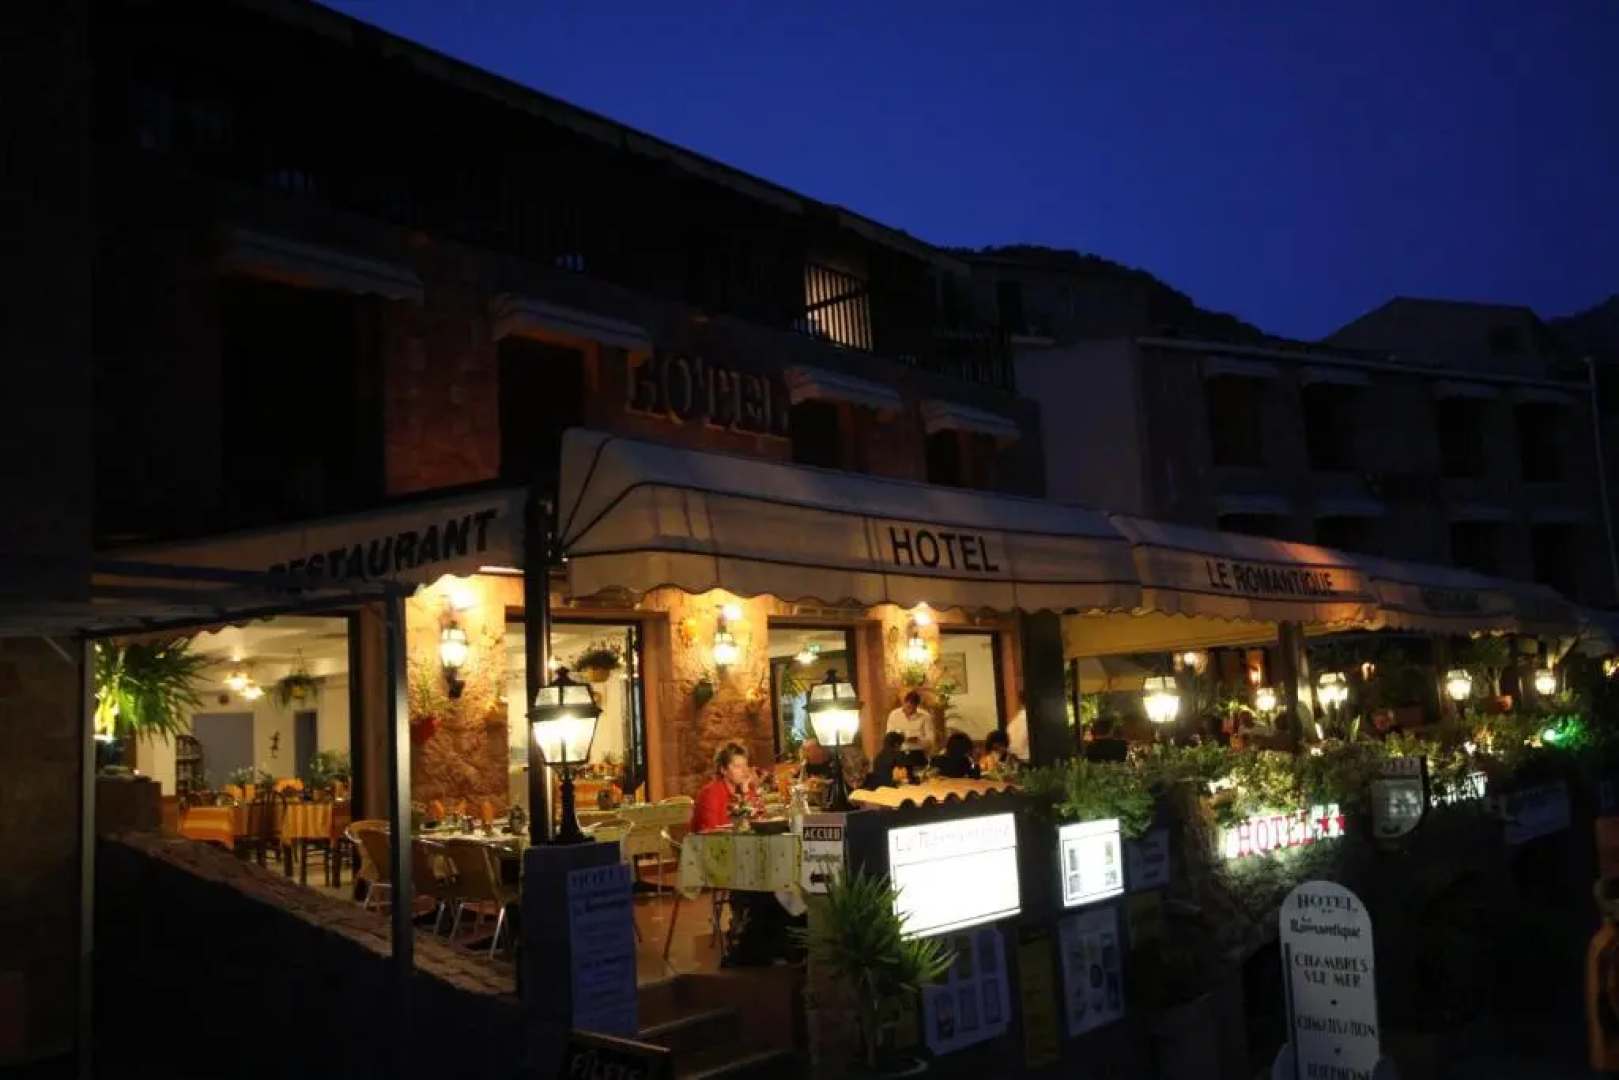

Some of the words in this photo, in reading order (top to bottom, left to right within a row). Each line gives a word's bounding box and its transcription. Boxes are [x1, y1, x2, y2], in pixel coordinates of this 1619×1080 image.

[624, 350, 792, 440] HOTEL
[889, 526, 1000, 572] HOTEL
[1206, 560, 1232, 589] LE
[1297, 894, 1358, 912] HOTEL
[1290, 919, 1360, 941] Romantique
[1295, 953, 1368, 974] CHAMBRES
[1333, 972, 1361, 988] MER
